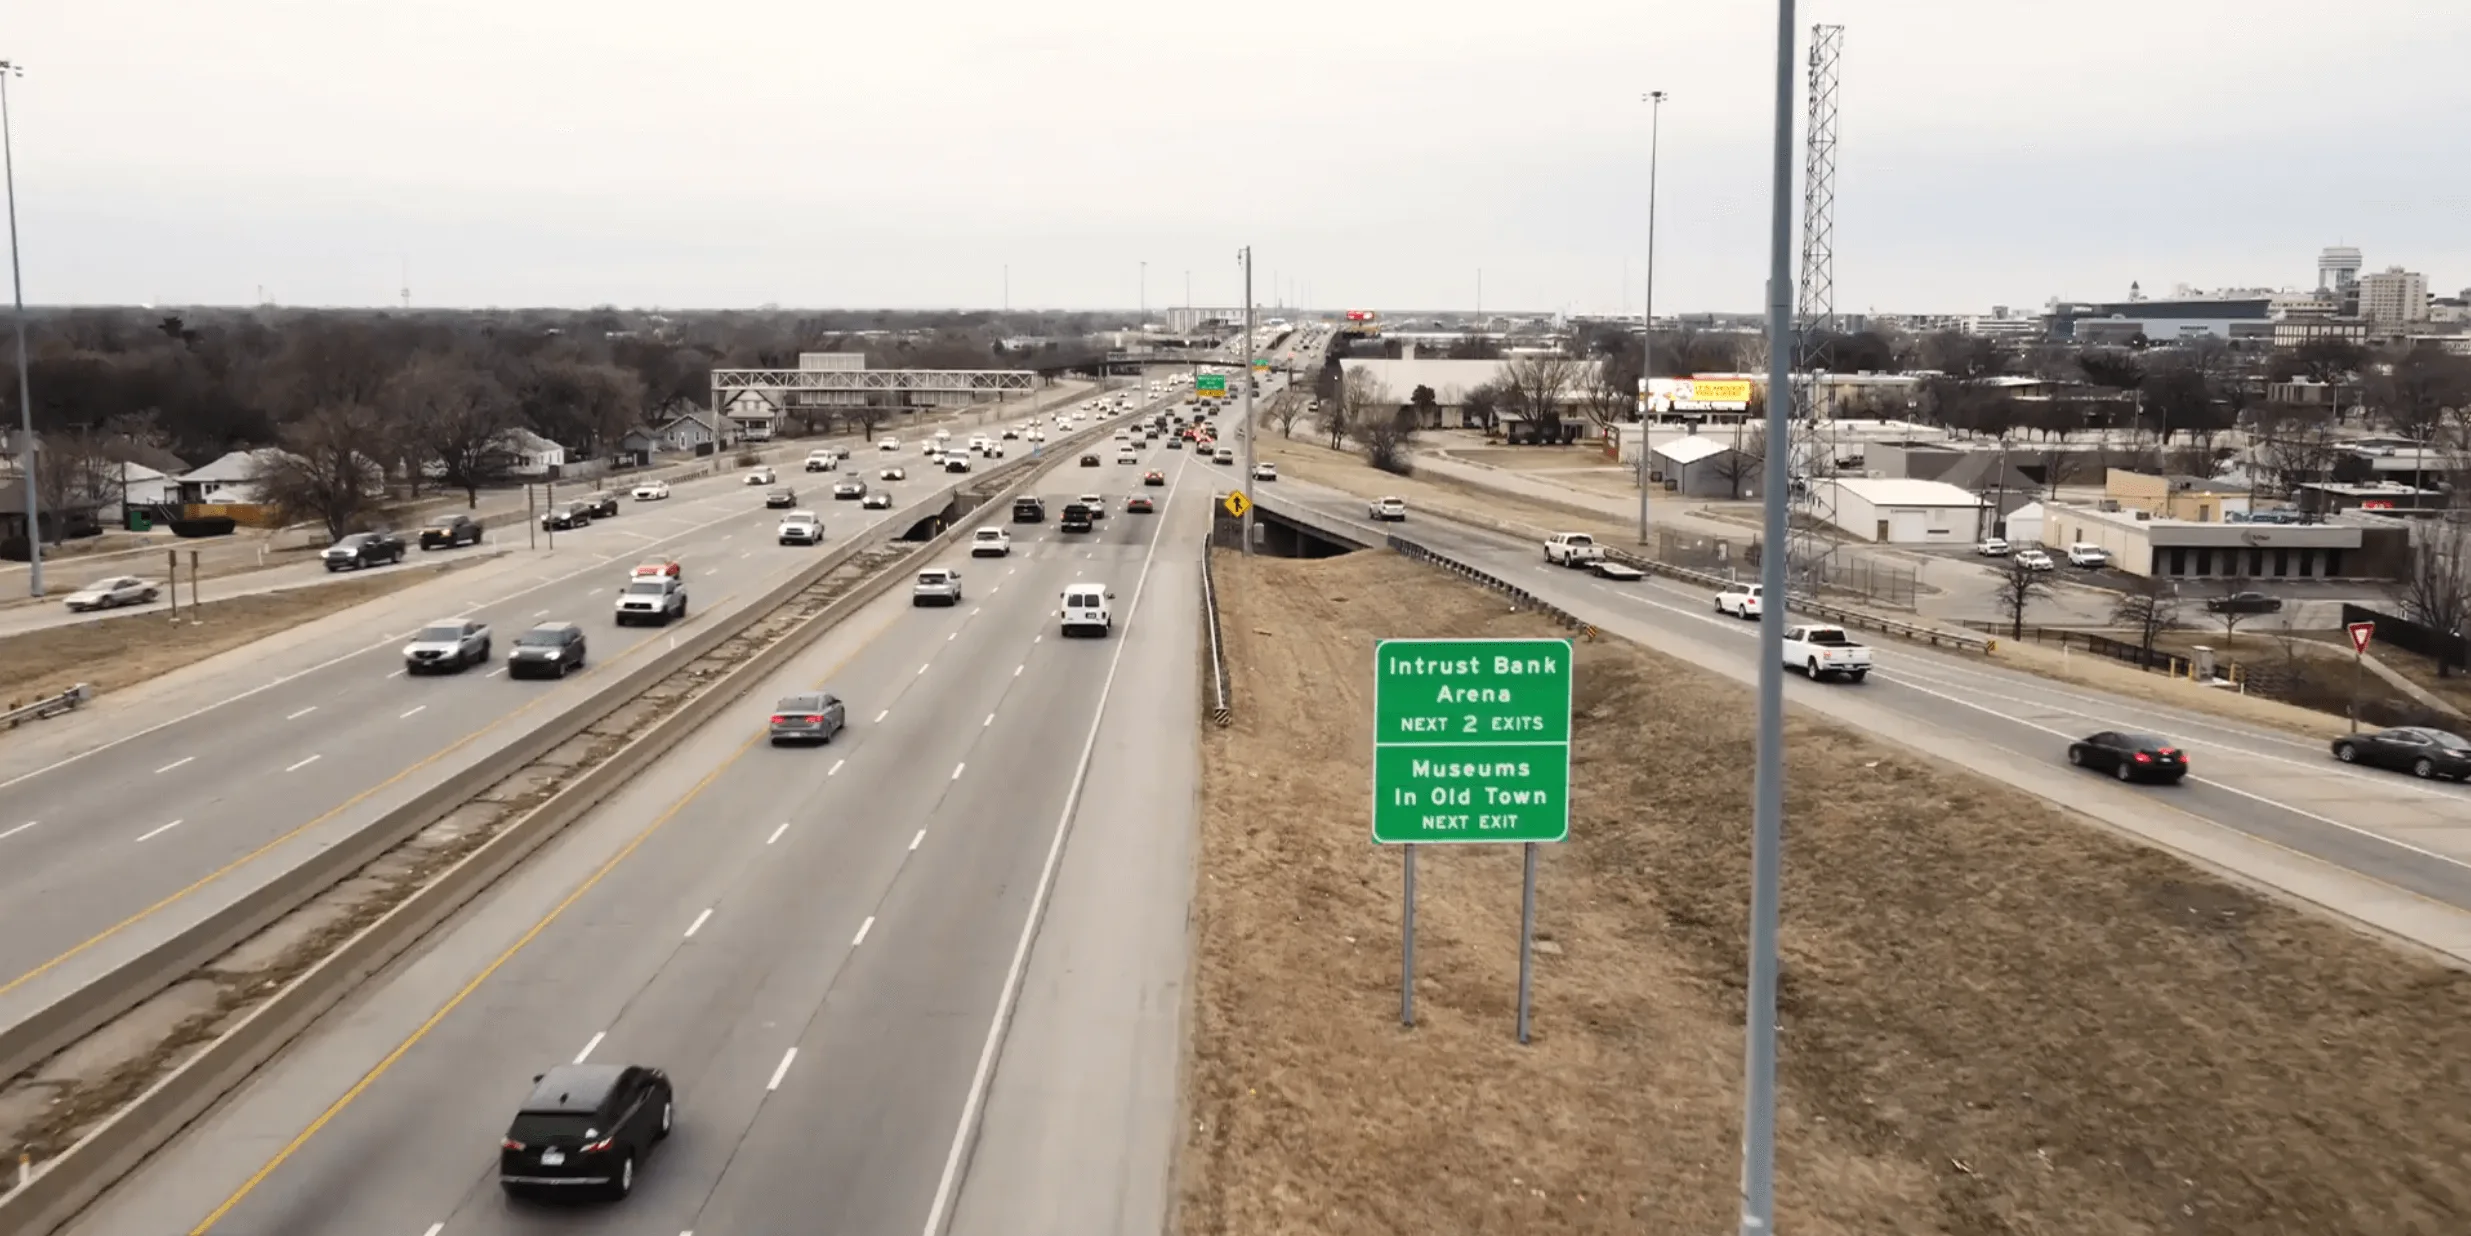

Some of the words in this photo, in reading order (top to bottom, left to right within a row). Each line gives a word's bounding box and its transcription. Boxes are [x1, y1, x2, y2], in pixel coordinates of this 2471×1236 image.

[1390, 656, 1480, 675] Intrust
[1494, 656, 1556, 675] Bank
[1436, 684, 1511, 703] Arena
[1401, 717, 1448, 732] NEXT
[1462, 715, 1478, 733] 2
[1491, 716, 1544, 731] EXITS
[1412, 759, 1530, 778] Museums
[1395, 787, 1417, 806] In
[1430, 787, 1471, 805] Old
[1484, 786, 1547, 805] Town
[1422, 815, 1469, 830] NEXT
[1479, 814, 1518, 829] EXIT
